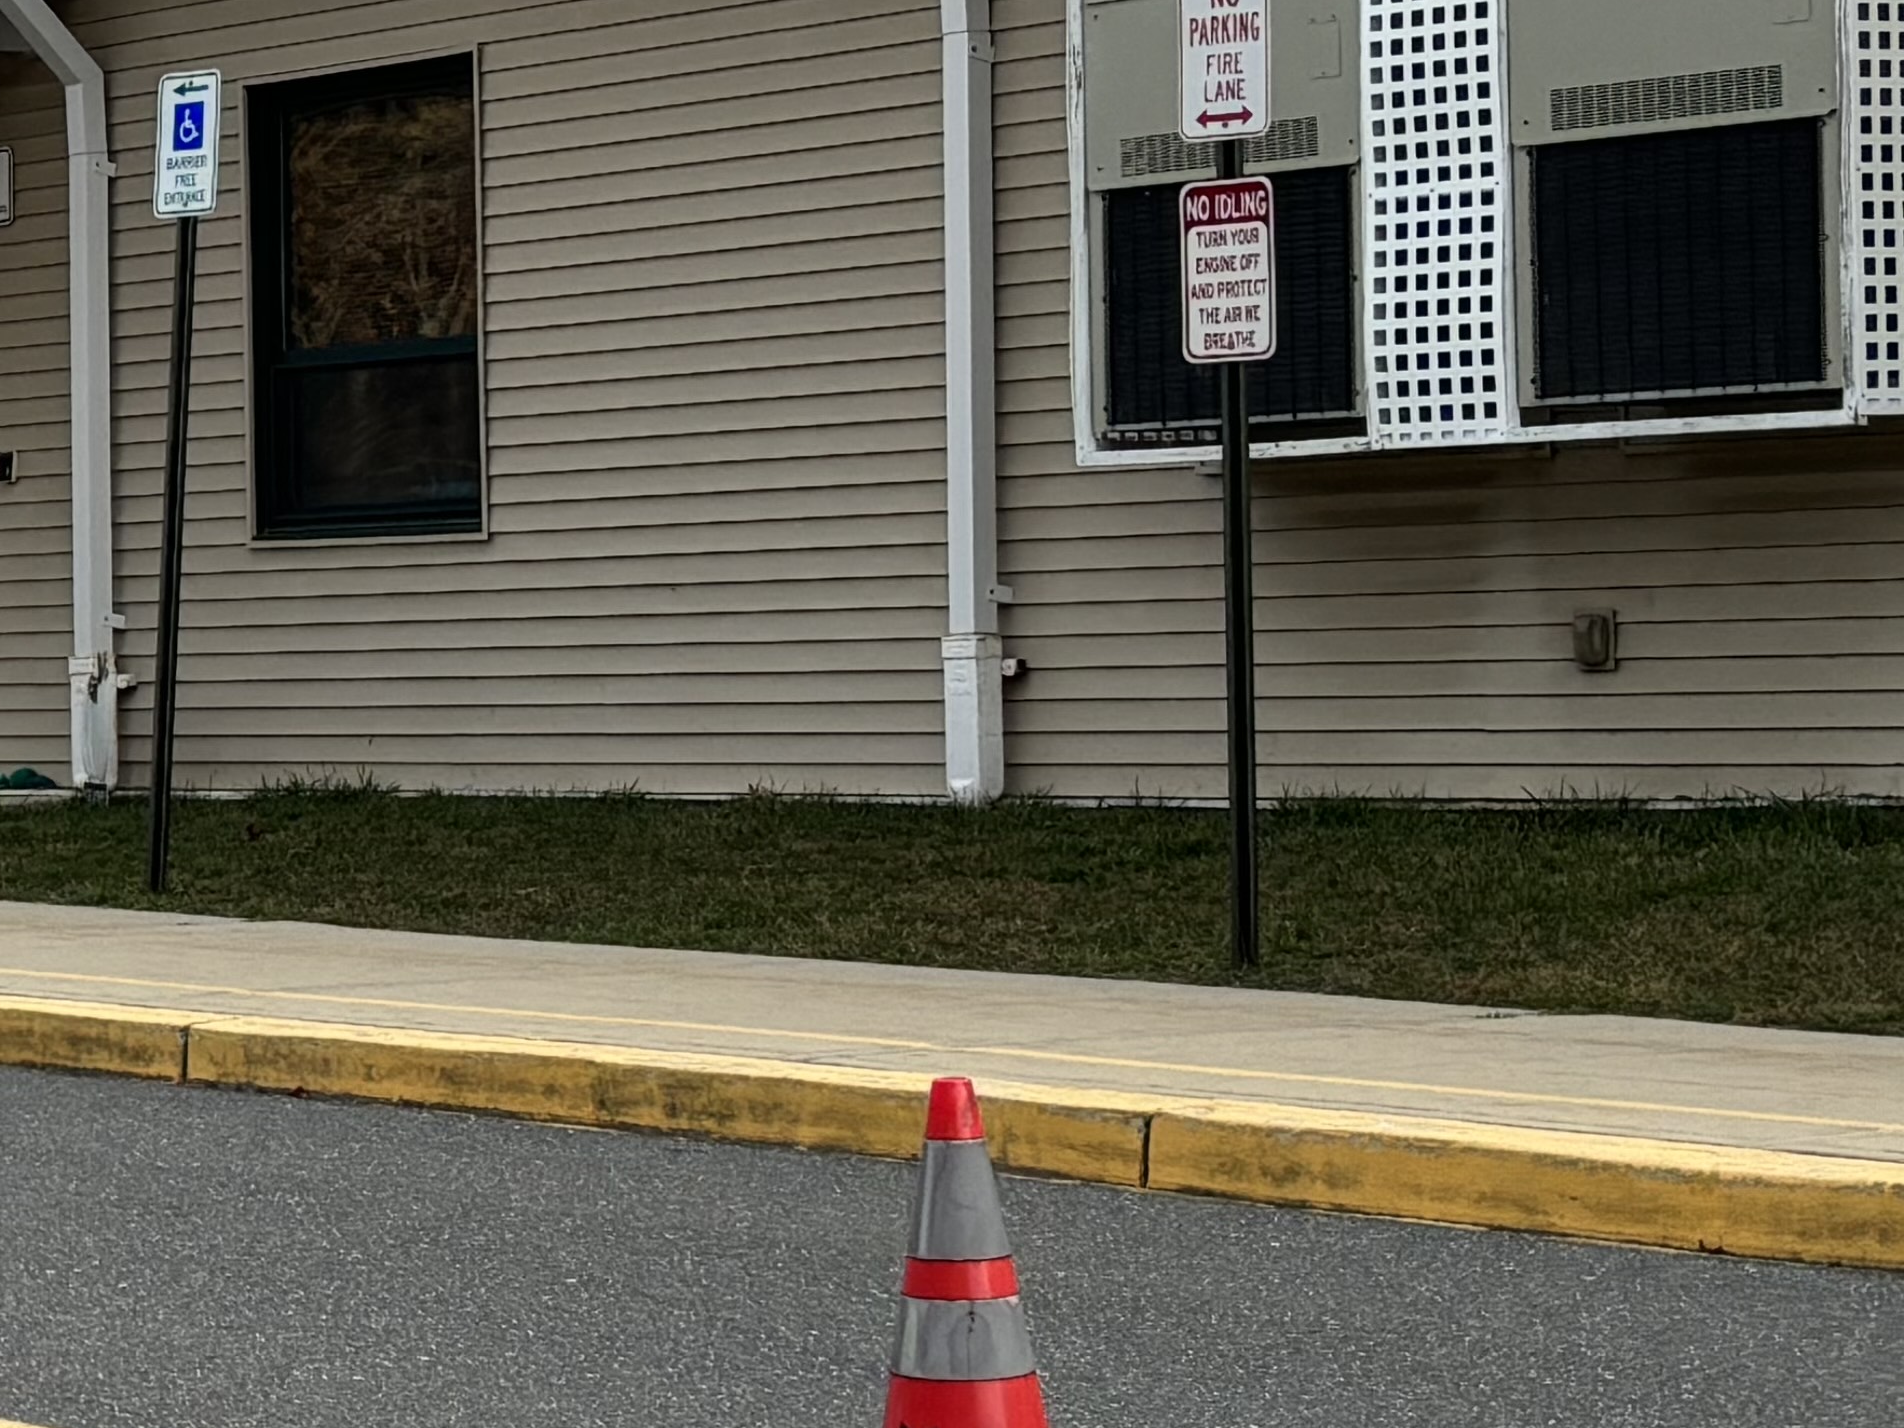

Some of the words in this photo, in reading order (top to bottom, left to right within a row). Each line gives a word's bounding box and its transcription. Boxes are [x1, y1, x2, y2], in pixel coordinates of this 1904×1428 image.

[1189, 11, 1260, 47] PARKING
[1206, 51, 1244, 76] FIRE
[1204, 78, 1246, 103] LANE
[166, 154, 208, 171] BARRIER
[175, 172, 197, 188] FREE
[1186, 195, 1210, 221] NO
[1215, 190, 1267, 220] IDLING
[1196, 230, 1227, 248] TURN
[1230, 227, 1259, 245] YOUR
[1196, 255, 1237, 275] ENGINE
[1240, 253, 1261, 271] OFF
[1191, 282, 1214, 300] AND
[1217, 278, 1267, 299] PROTECT
[1199, 307, 1221, 324] THE
[1224, 305, 1242, 323] AIR
[1245, 304, 1261, 322] WE
[1204, 330, 1256, 351] BREATHE
